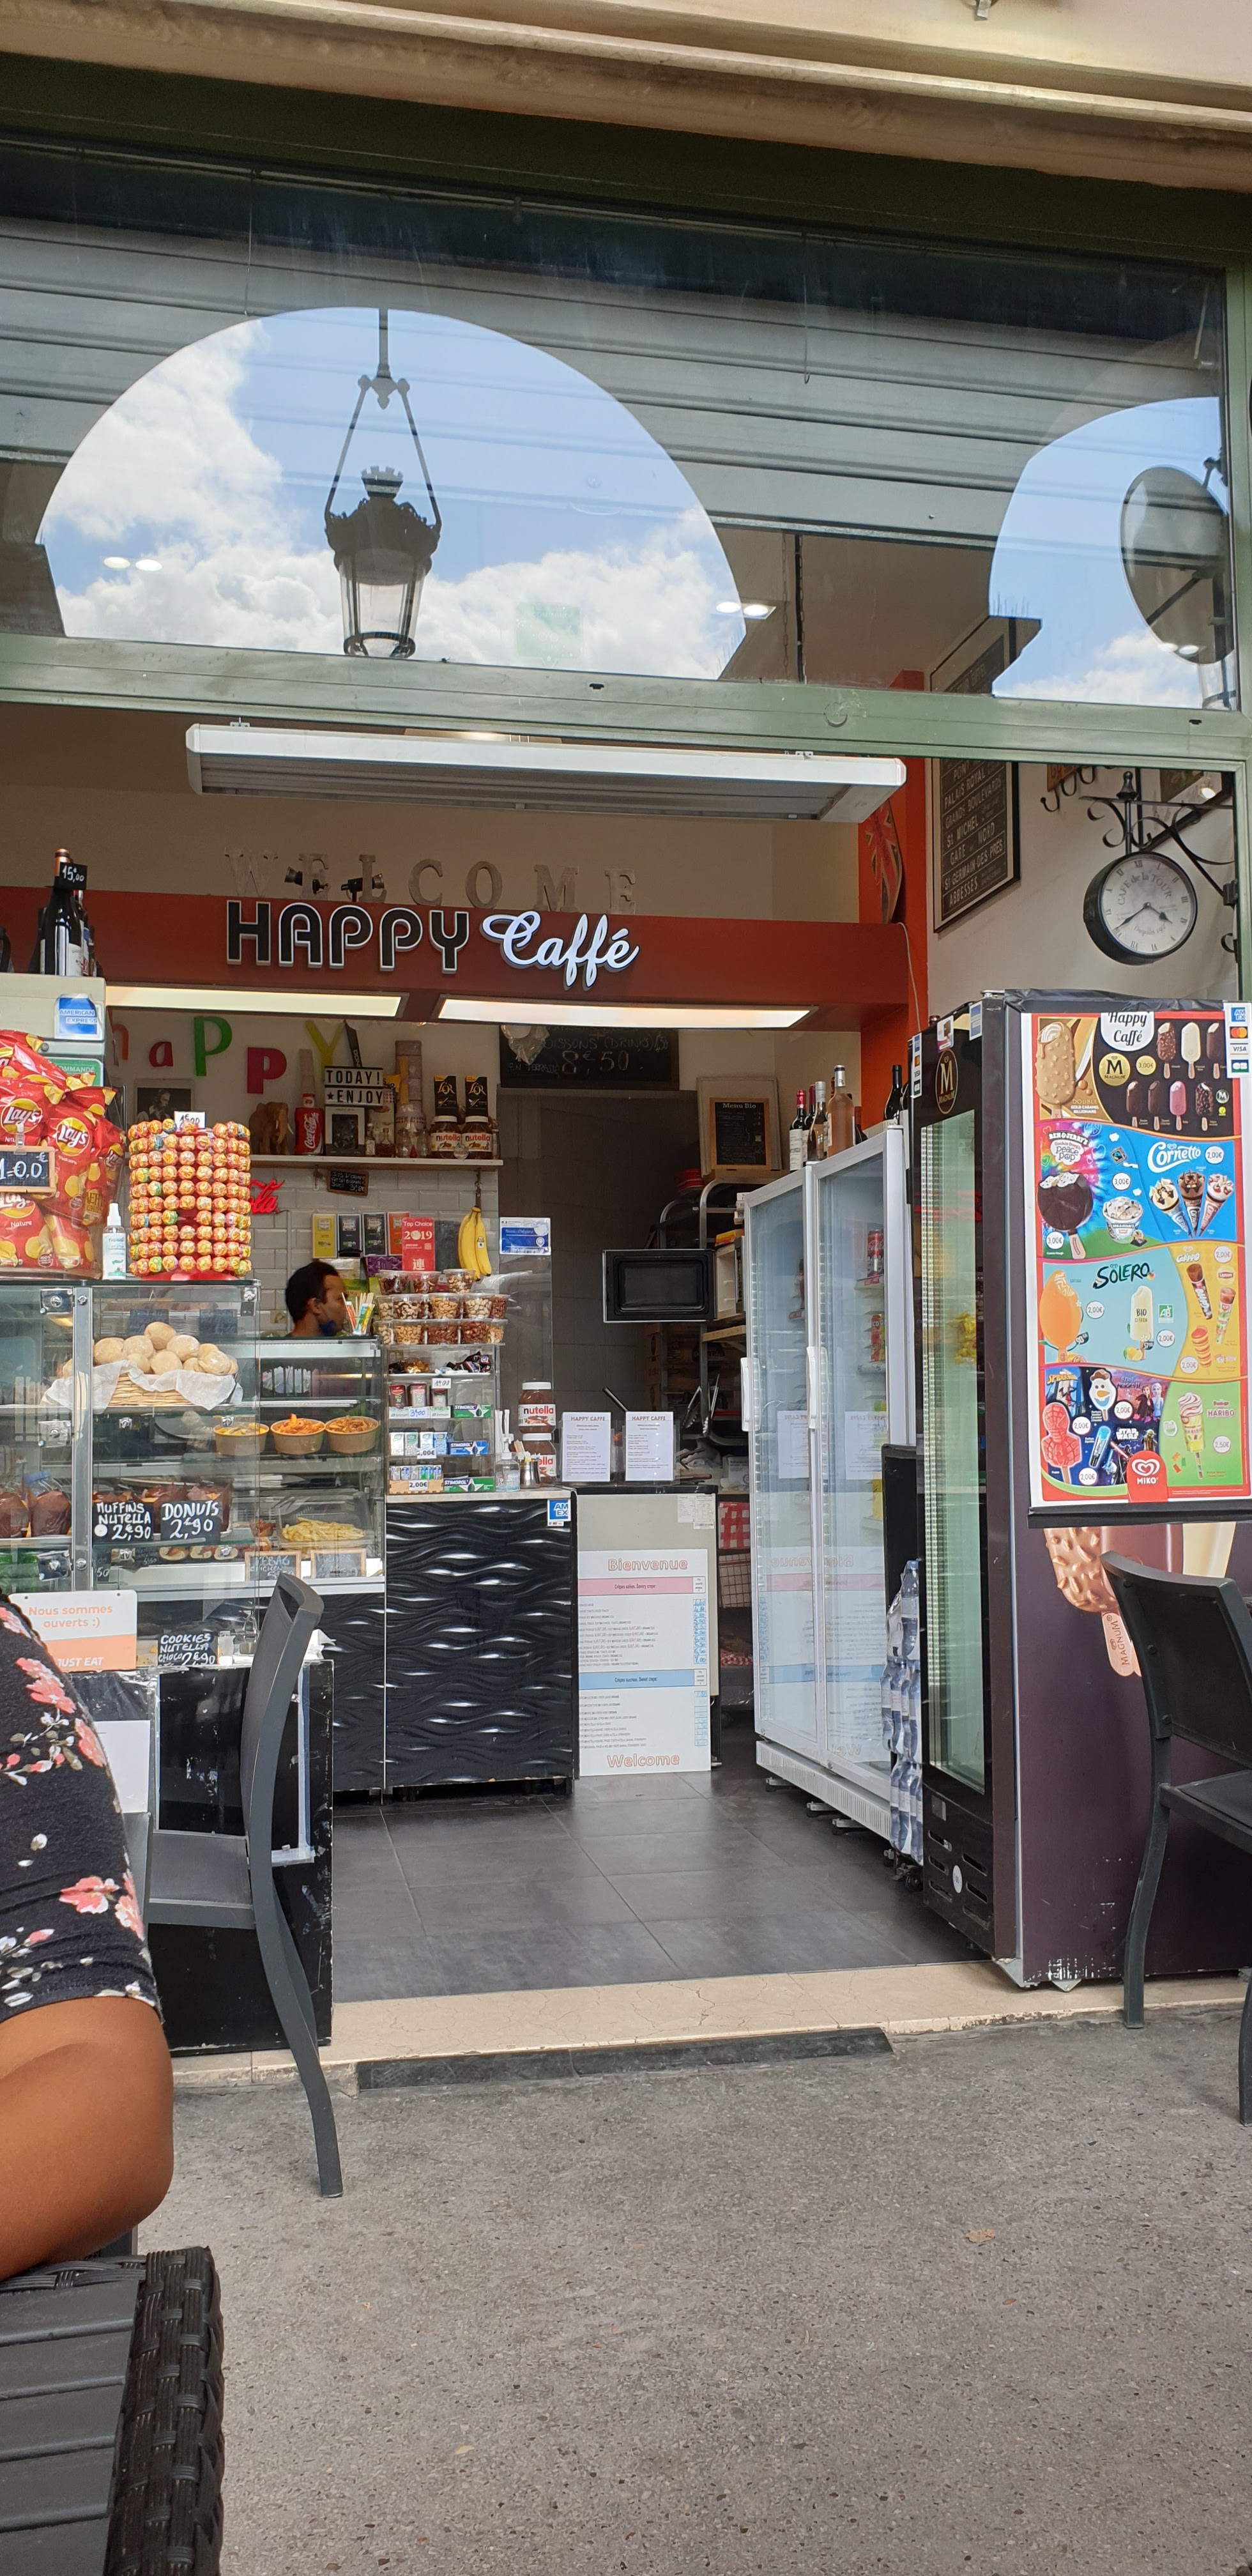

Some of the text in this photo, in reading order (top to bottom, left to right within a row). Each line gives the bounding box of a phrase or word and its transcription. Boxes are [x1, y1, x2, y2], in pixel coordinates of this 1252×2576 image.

[966, 767, 986, 791] ROYAL
[224, 847, 637, 914] WELCOME
[1151, 873, 1172, 899] TOUR
[226, 899, 639, 991] HAPPY Caffé
[1108, 1012, 1147, 1027] Happy
[544, 1036, 599, 1049] OISSONS
[1113, 1029, 1143, 1046] Caffé
[326, 1070, 380, 1085] TODAY!
[337, 1089, 383, 1104] ENJOY
[3, 1106, 42, 1125] Lay's
[58, 1124, 89, 1148] Lay's
[436, 1133, 460, 1142] nutella
[1055, 1146, 1080, 1156] peace
[1058, 1153, 1076, 1162] pop
[1147, 1141, 1202, 1174] Cornetto
[1114, 1177, 1129, 1186] 3,00€
[10, 1220, 33, 1229] Nature
[1048, 1236, 1063, 1245] 3,00€
[1093, 1262, 1150, 1289] SOLERO
[1136, 1308, 1147, 1317] BIO
[523, 1406, 554, 1414] nutella
[538, 1457, 553, 1465] ella
[96, 1501, 145, 1514] MUFFINS
[162, 1500, 219, 1521] DONUTS
[608, 1558, 689, 1571] Bienvenue
[28, 1605, 113, 1616] Nous sommes
[43, 1618, 89, 1628] ouverts
[160, 1632, 211, 1644] COOKIES
[1111, 1620, 1130, 1665] MAGNUM
[160, 1642, 210, 1653] NUTELLA
[57, 1657, 104, 1667] JUST EAT
[158, 1652, 183, 1663] CHOCO
[607, 1753, 680, 1767] Welcome
